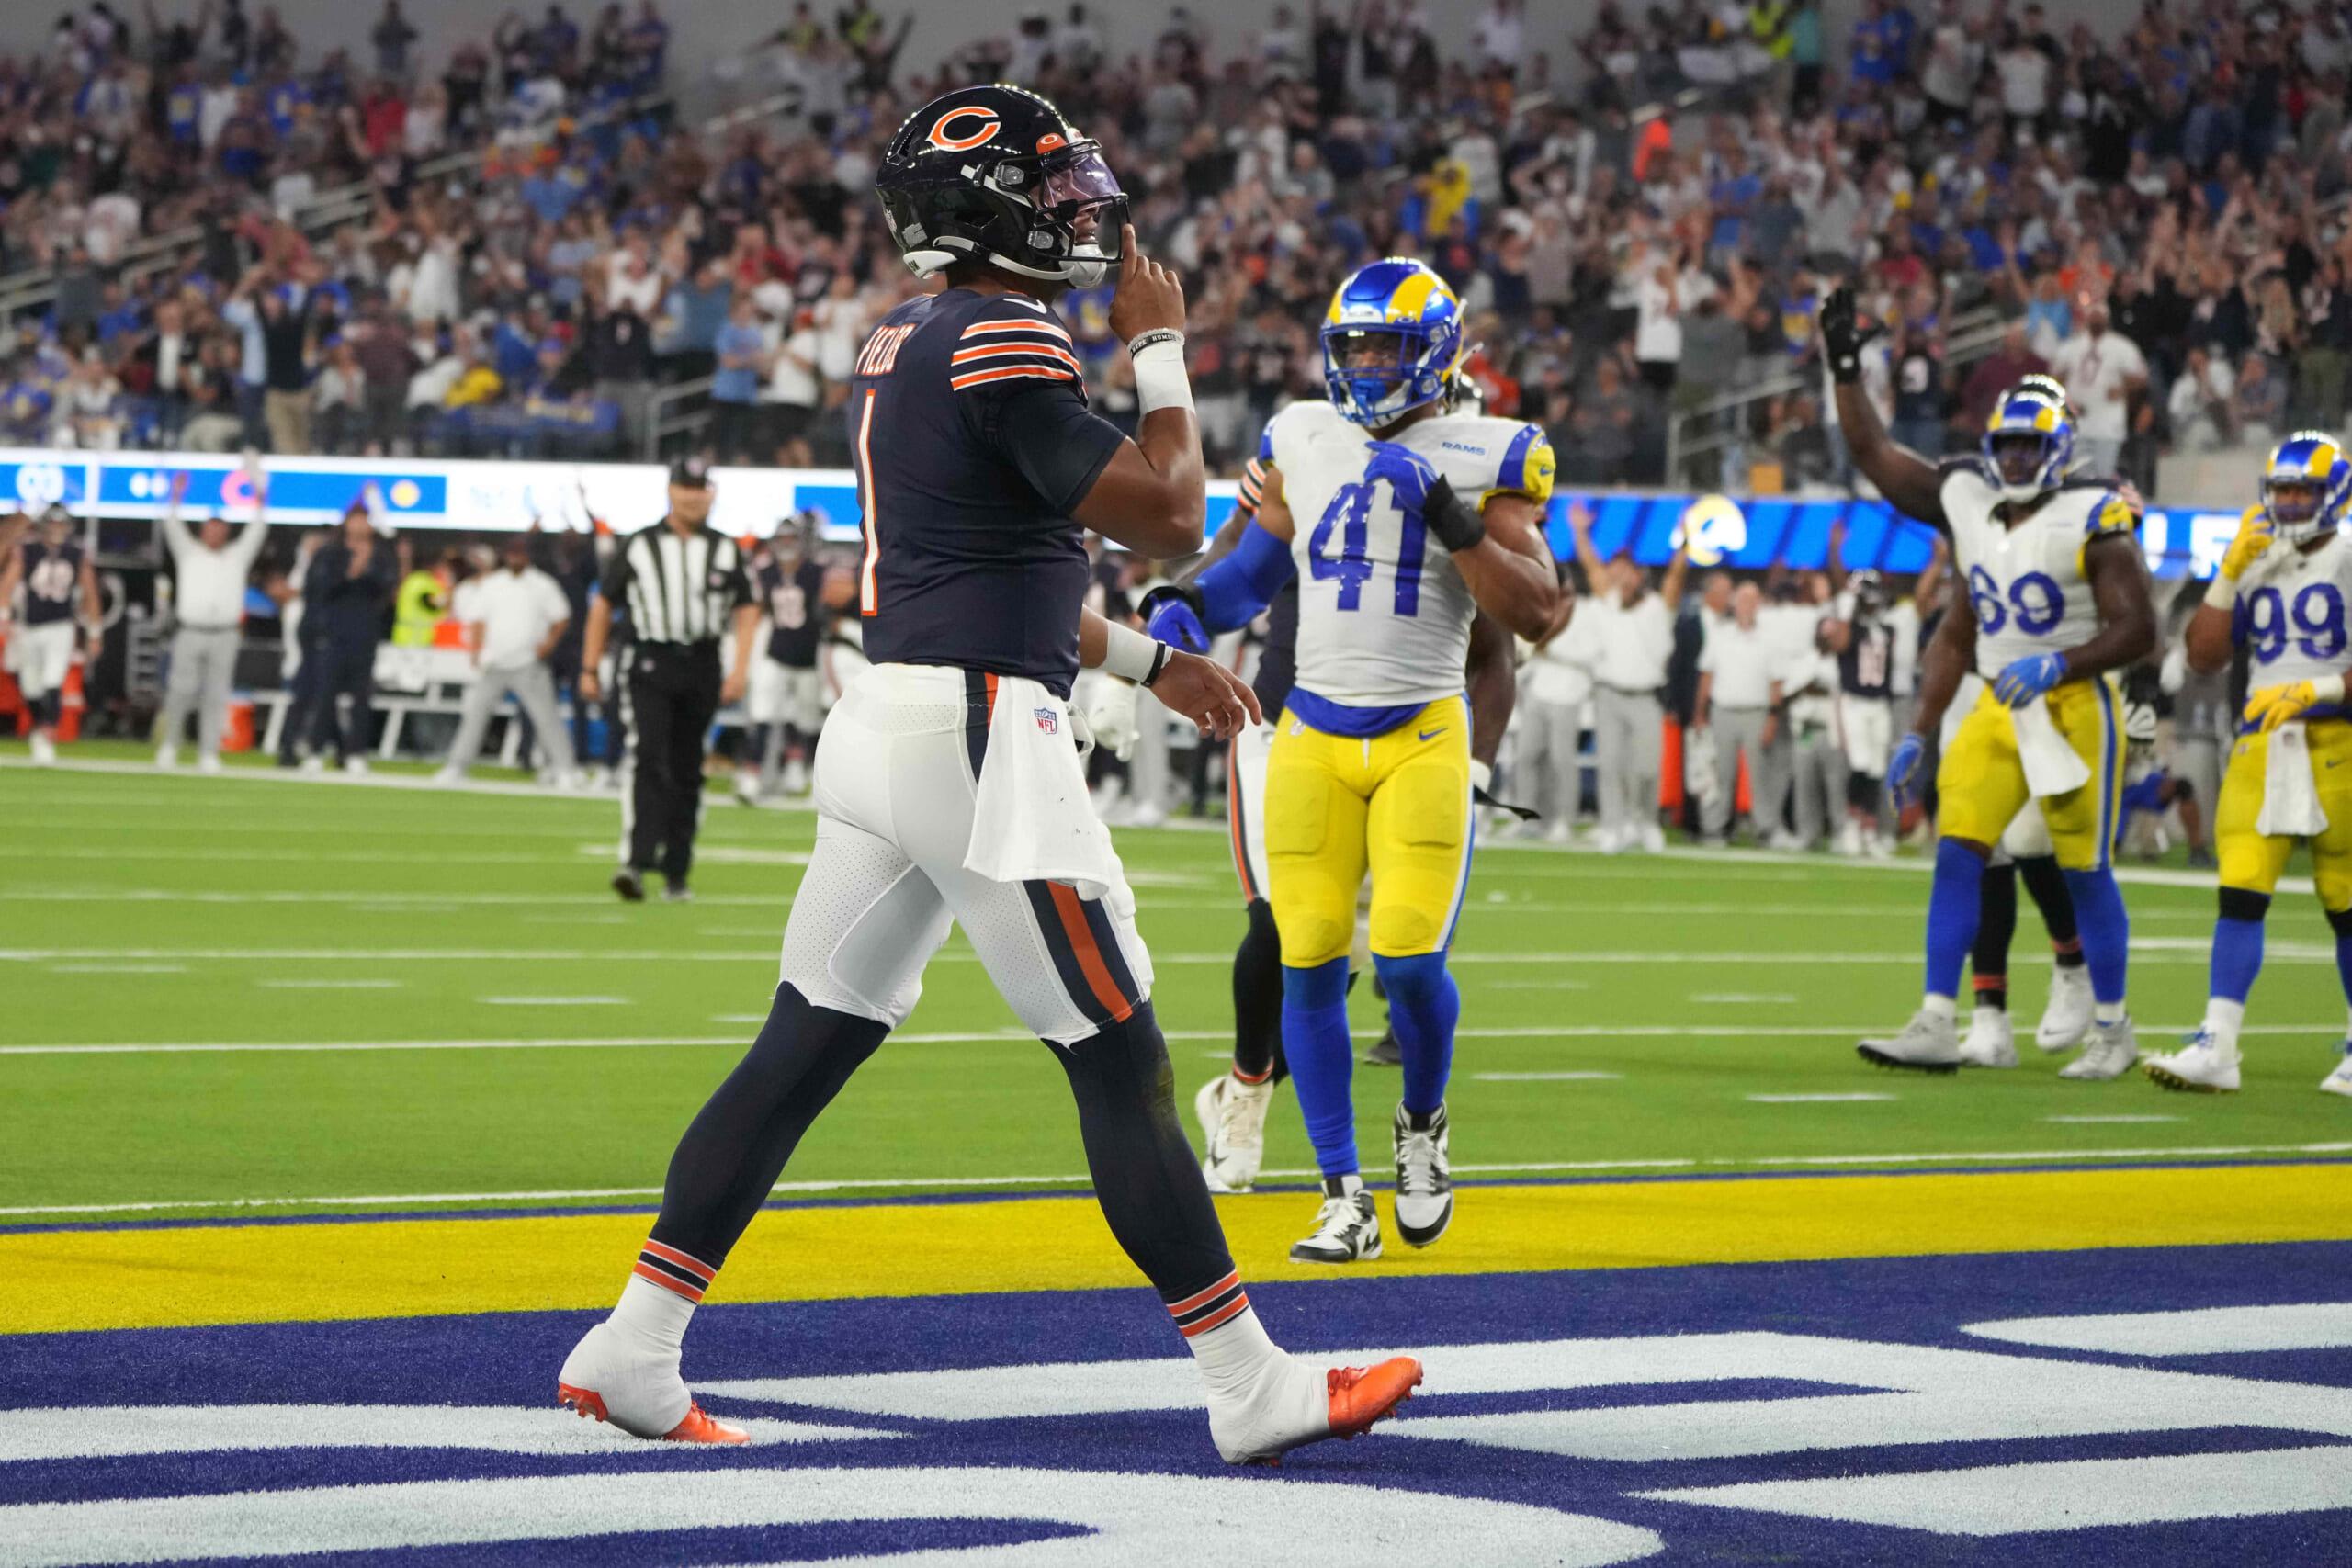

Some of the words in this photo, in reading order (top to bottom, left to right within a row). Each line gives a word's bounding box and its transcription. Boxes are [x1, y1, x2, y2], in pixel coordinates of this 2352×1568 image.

[1441, 441, 1486, 456] RAMS
[859, 389, 879, 616] 1
[1308, 483, 1426, 617] 41
[1969, 563, 2065, 636] 69
[2248, 582, 2347, 667] 99
